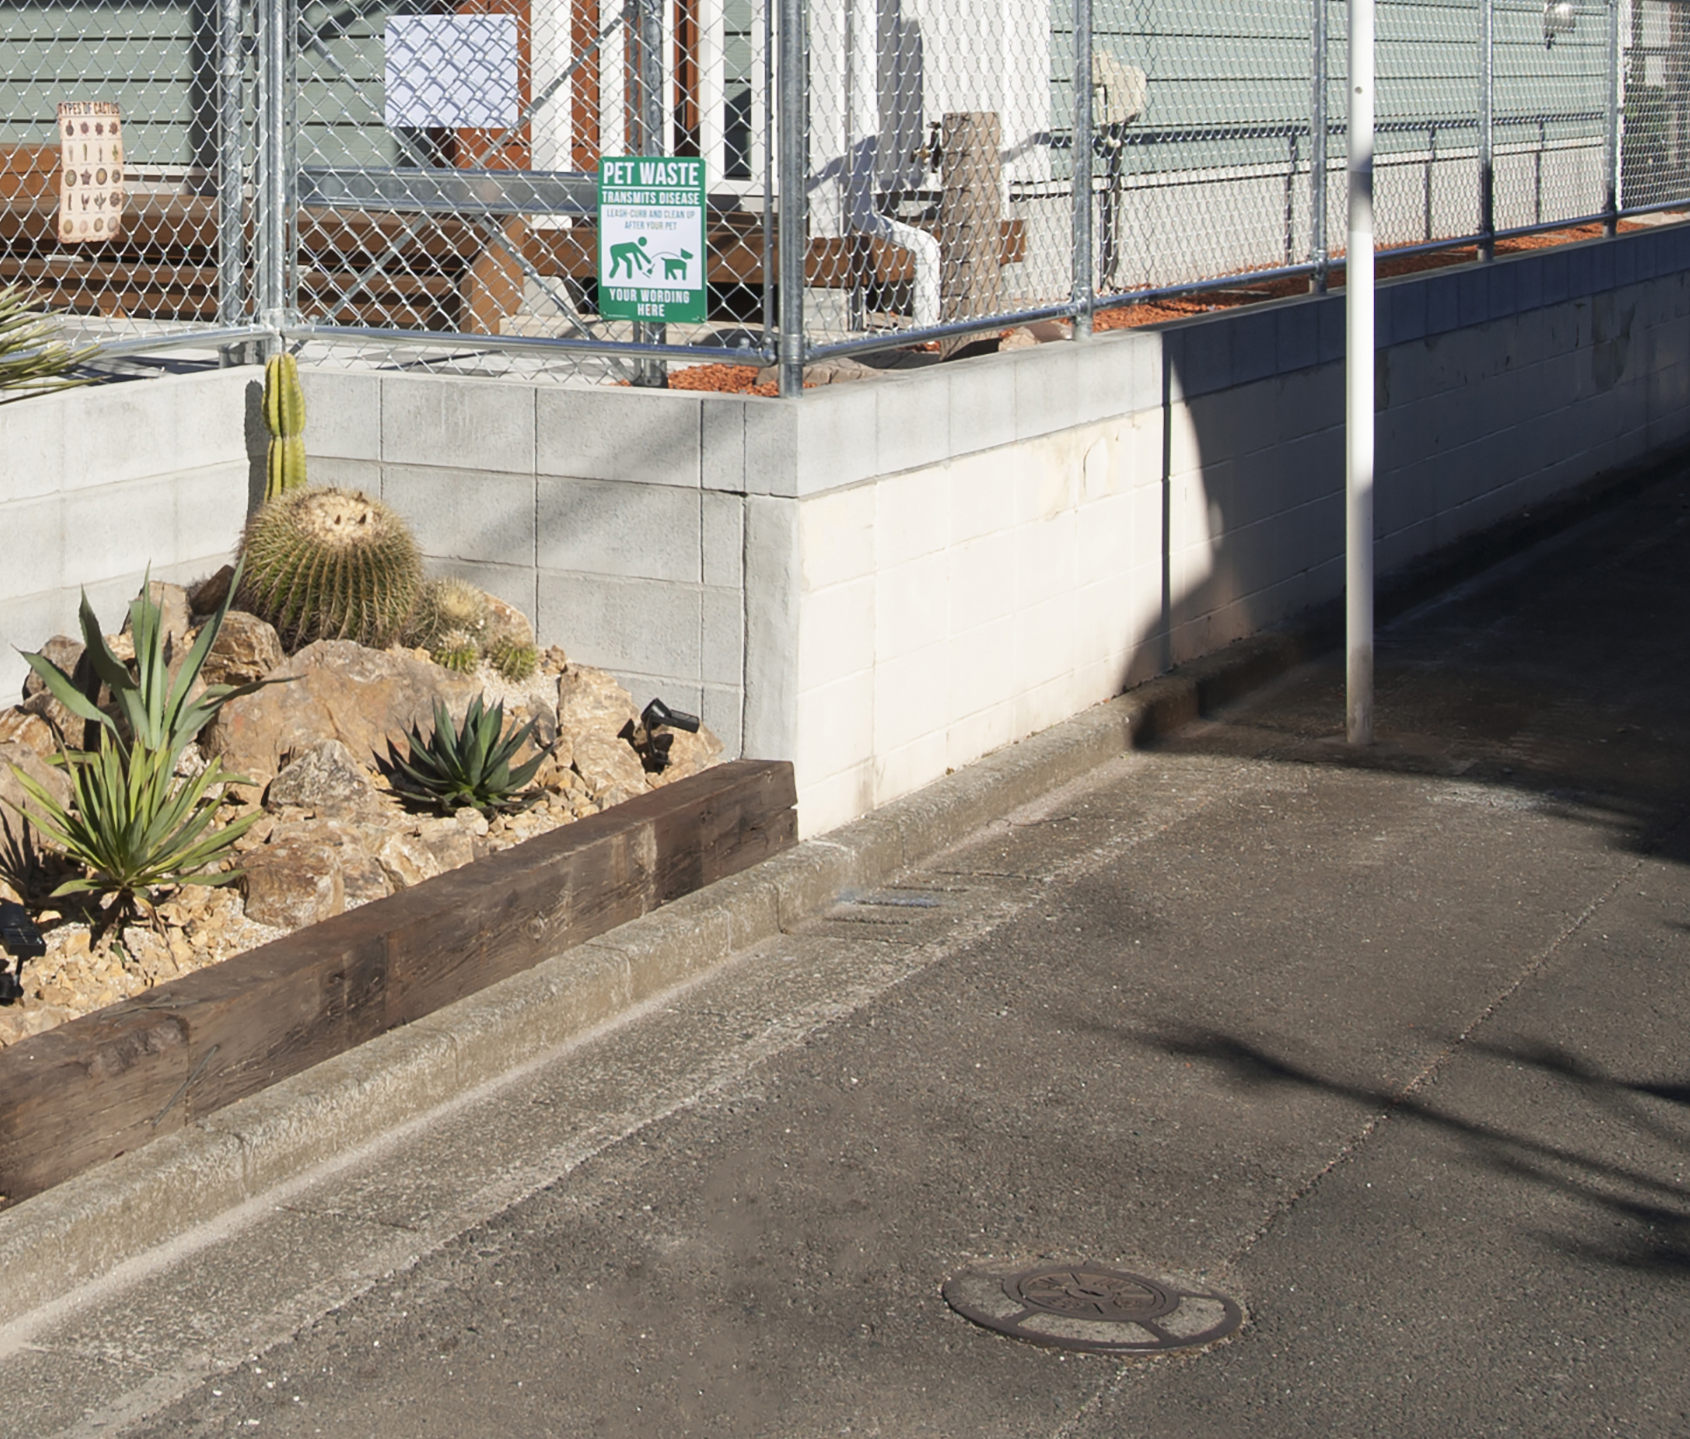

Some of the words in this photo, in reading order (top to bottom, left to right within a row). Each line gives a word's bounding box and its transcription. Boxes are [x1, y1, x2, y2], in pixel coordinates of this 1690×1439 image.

[58, 102, 82, 115] TYPES
[83, 102, 91, 114] OF
[94, 102, 120, 115] CACTUS
[603, 162, 635, 184] PET
[639, 162, 700, 185] WASTE
[602, 191, 656, 204] TRANSMITS
[659, 192, 700, 205] DISEASE
[606, 209, 647, 218] LEASH-CURB
[649, 210, 662, 219] AND
[664, 210, 685, 219] CLEAN
[686, 211, 695, 219] UP
[624, 221, 645, 229] AFTER
[646, 221, 663, 230] YOUR
[665, 222, 677, 230] PET
[609, 288, 637, 301] YOUR
[640, 289, 690, 304] WORDING
[637, 303, 665, 317] HERE
